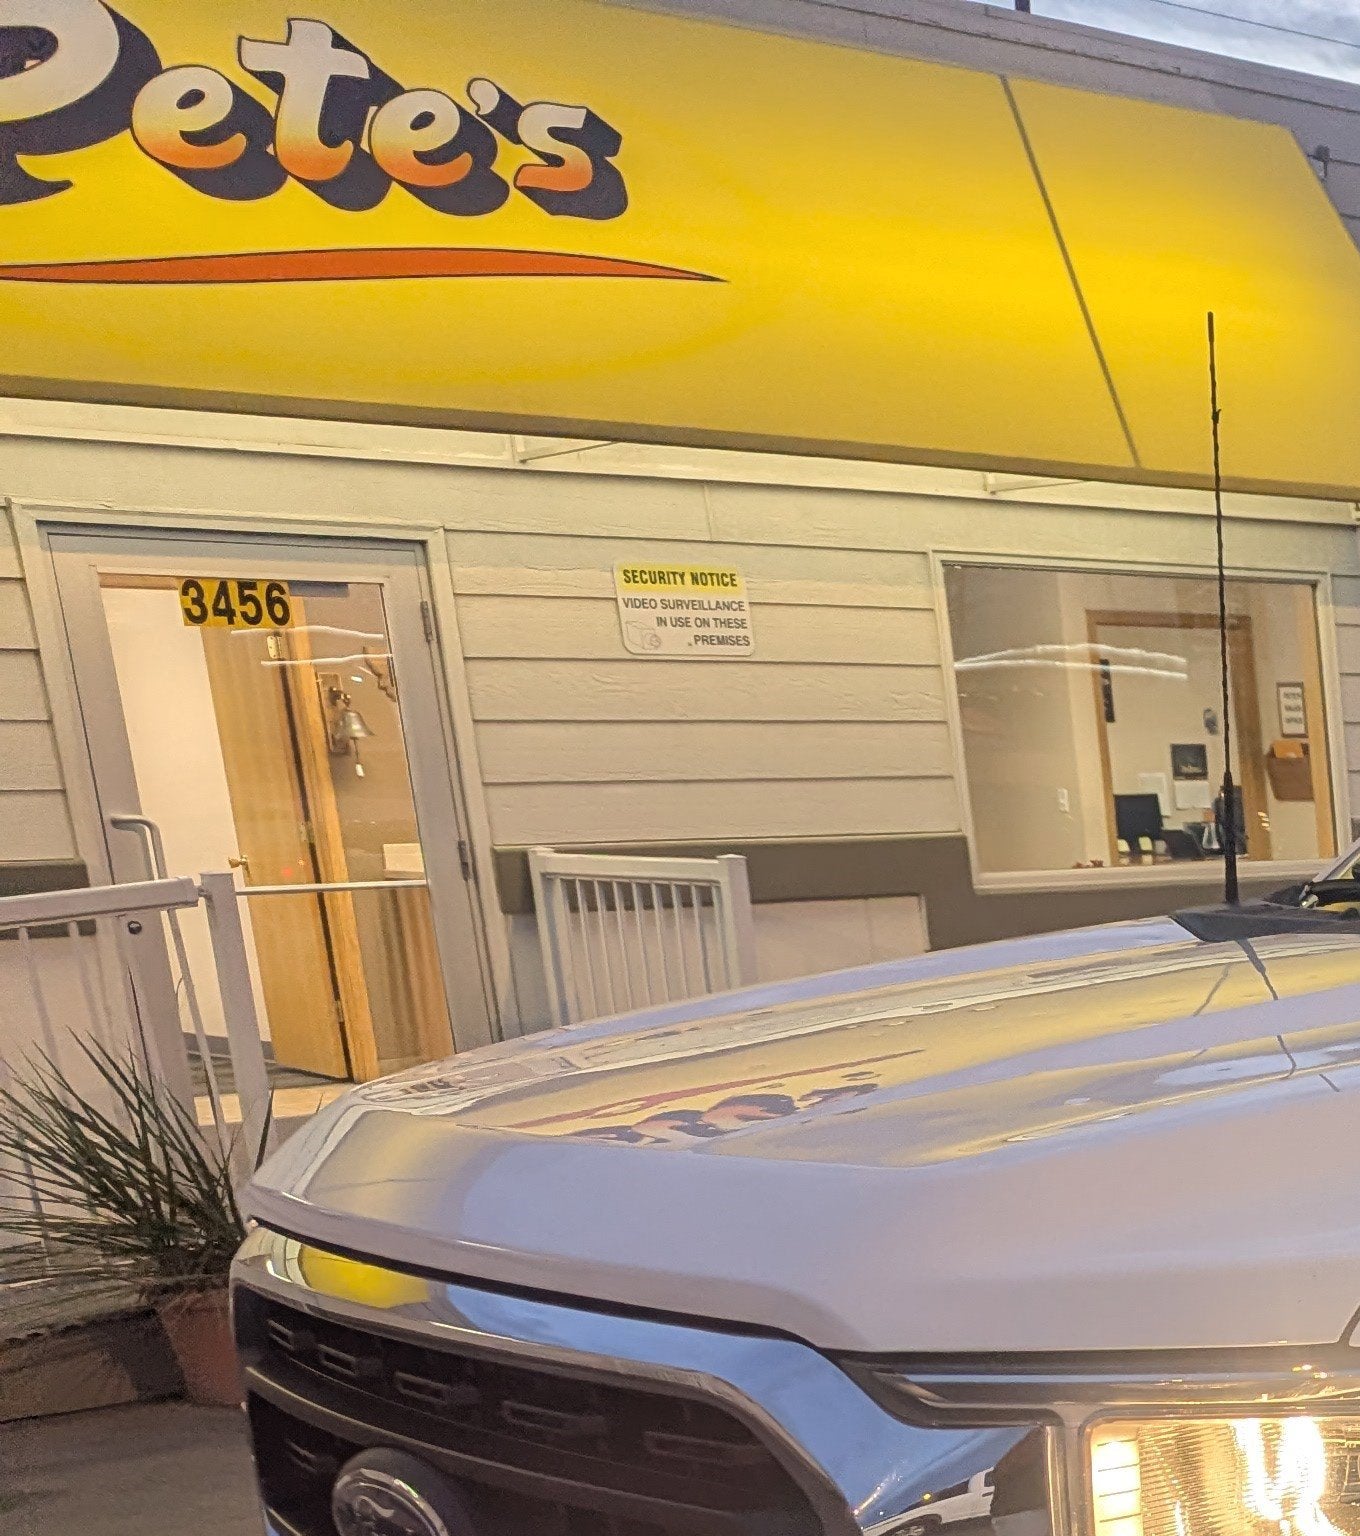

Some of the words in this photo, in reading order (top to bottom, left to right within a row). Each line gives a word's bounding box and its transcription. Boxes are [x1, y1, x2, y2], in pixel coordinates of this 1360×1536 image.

[623, 569, 685, 585] SECURITY
[690, 571, 738, 587] NOTICE
[181, 578, 291, 626] 3456
[622, 598, 658, 609] VIDEO
[660, 599, 745, 611] SURVEILLANCE
[656, 616, 667, 627] IN
[670, 617, 692, 628] USE
[695, 617, 711, 628] ON
[714, 618, 748, 629] THESE
[694, 635, 750, 647] PREMISES
